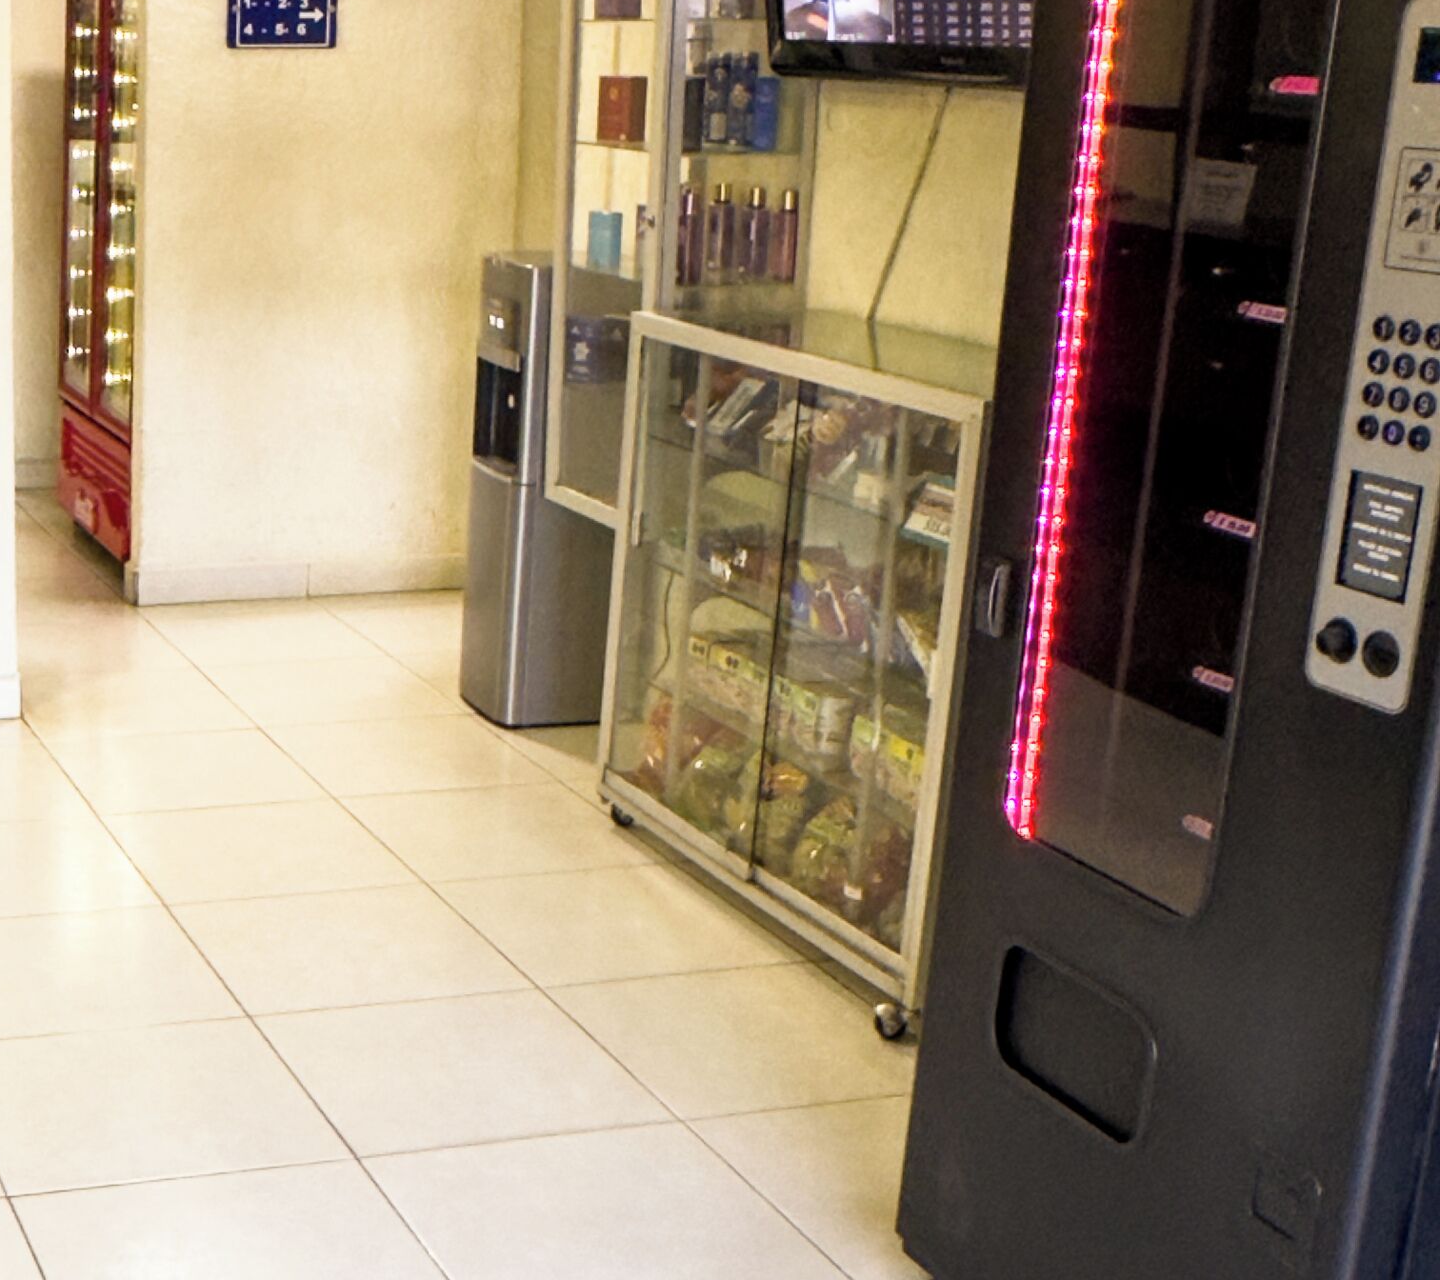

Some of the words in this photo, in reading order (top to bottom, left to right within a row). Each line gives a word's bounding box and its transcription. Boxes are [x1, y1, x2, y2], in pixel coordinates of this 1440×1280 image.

[243, 23, 254, 36] 4
[296, 23, 307, 36] 6
[1379, 320, 1388, 336] 1
[1404, 323, 1414, 340] 2
[1372, 353, 1384, 370] 4
[1398, 358, 1408, 377] 5
[1424, 361, 1436, 379] 6
[1369, 385, 1378, 402] 7
[1418, 395, 1430, 413] 9
[1387, 423, 1398, 442] 0
